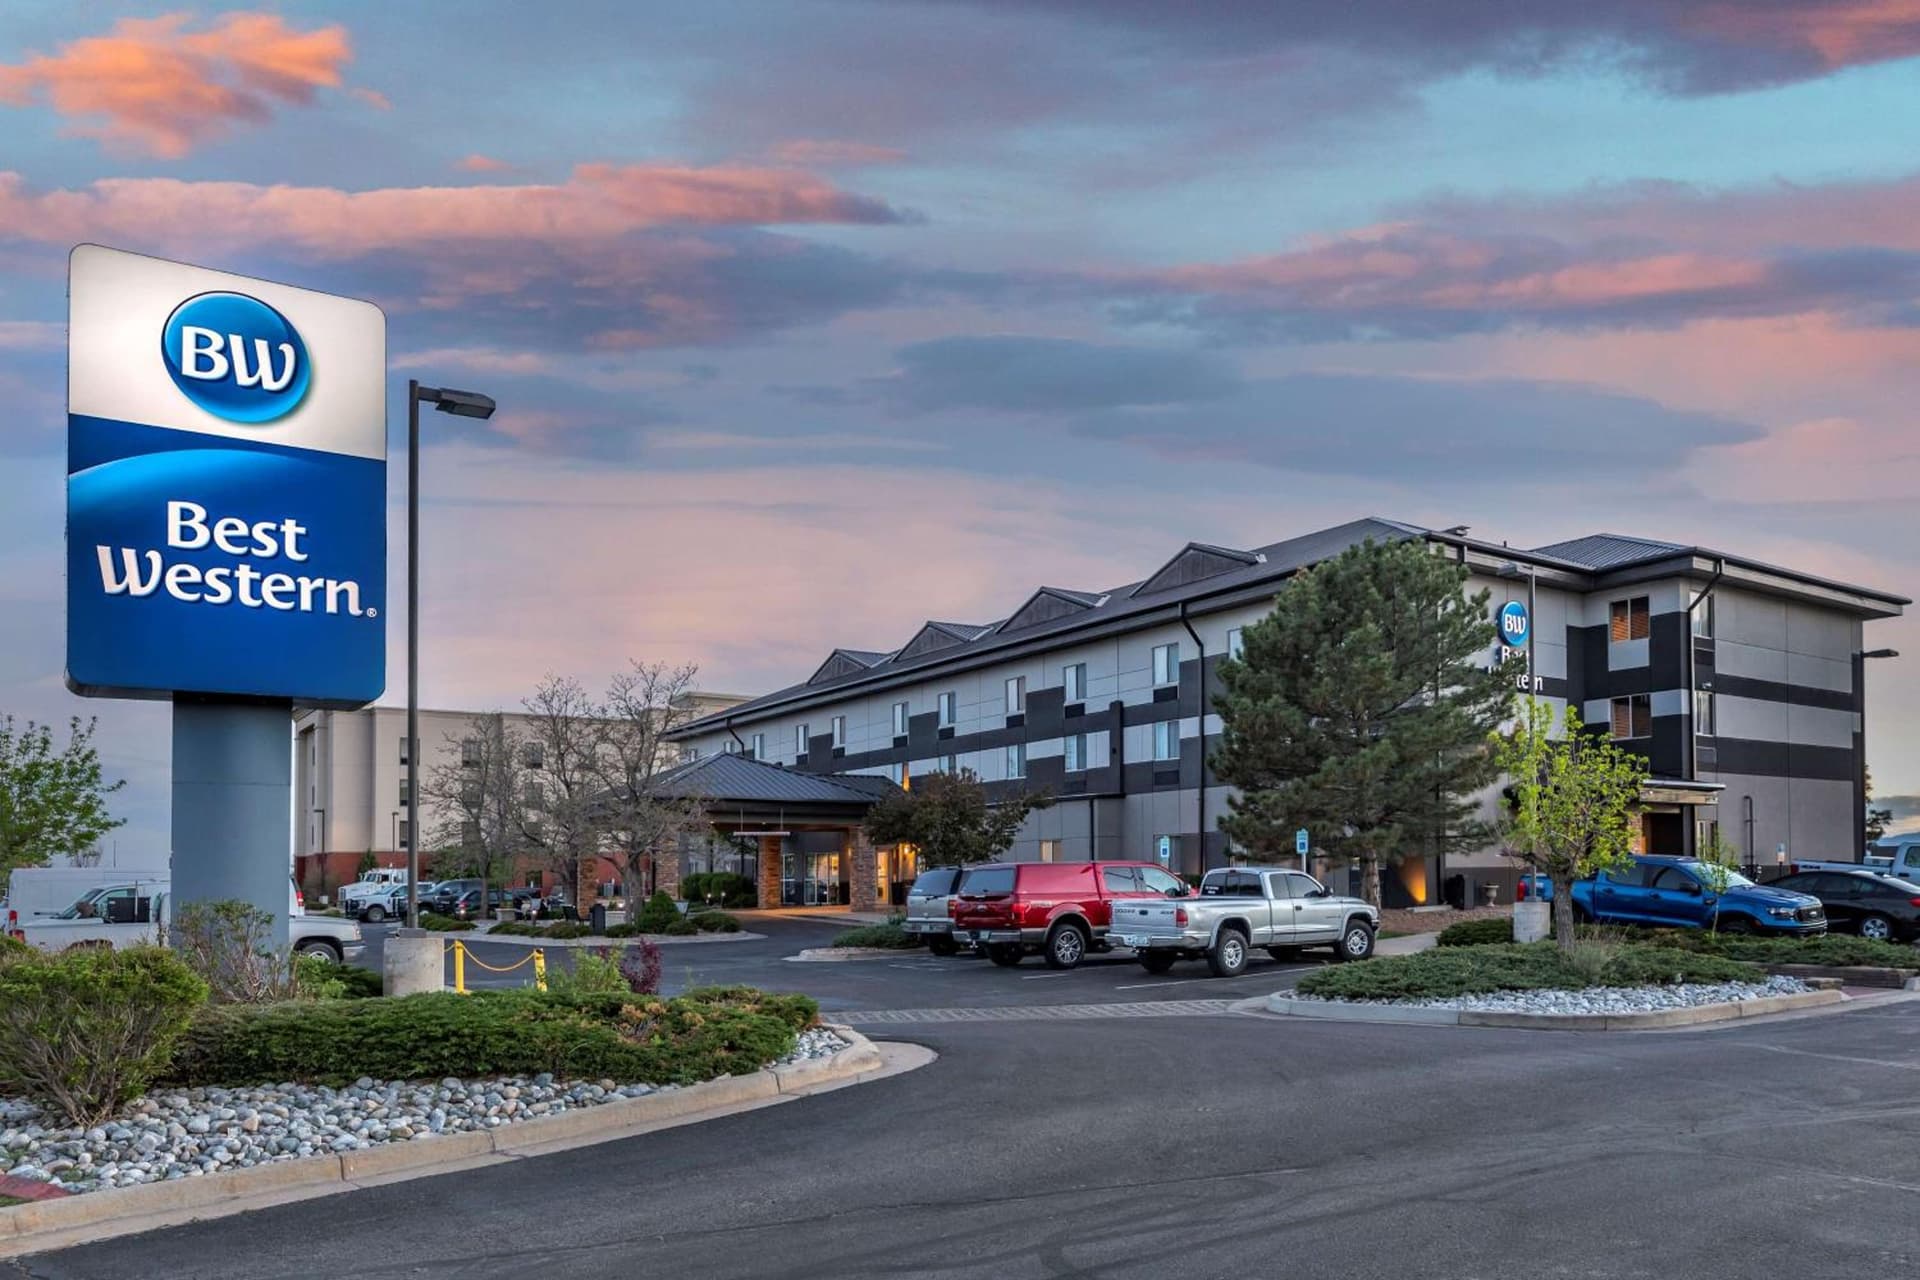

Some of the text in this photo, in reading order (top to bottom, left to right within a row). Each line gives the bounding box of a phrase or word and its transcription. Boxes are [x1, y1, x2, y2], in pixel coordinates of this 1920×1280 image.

[181, 325, 296, 391] BW
[167, 500, 309, 562] Best
[96, 544, 364, 616] Western
[1504, 613, 1527, 635] BW
